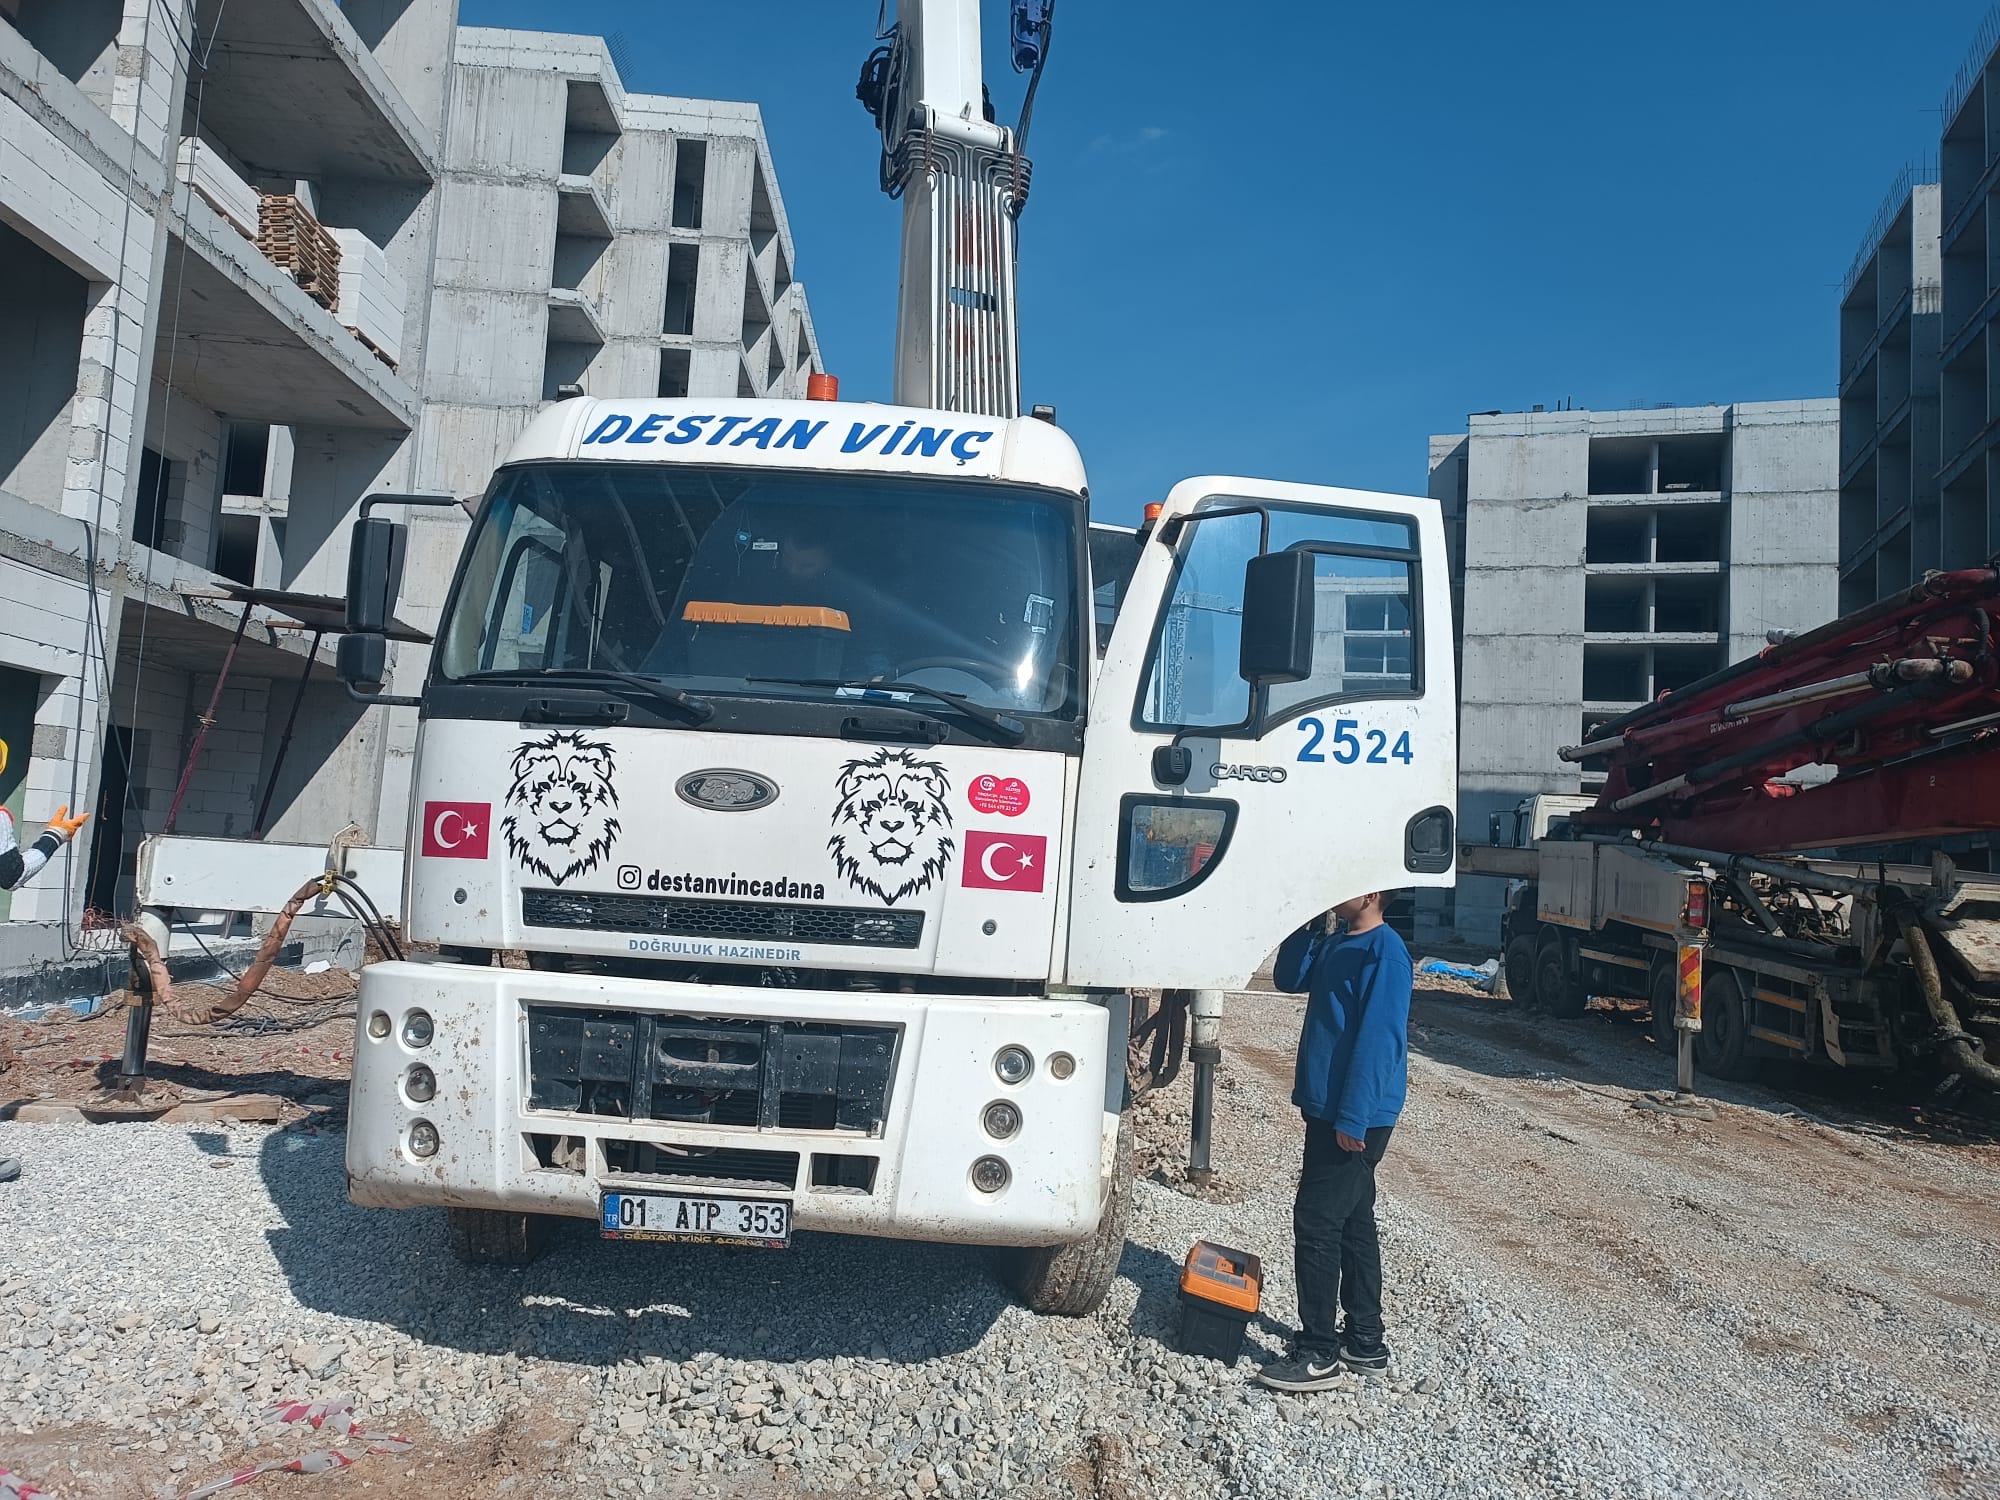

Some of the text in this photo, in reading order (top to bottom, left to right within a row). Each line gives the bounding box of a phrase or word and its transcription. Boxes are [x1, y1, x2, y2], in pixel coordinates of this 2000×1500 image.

[582, 414, 994, 466] DESTAN VİNÇ
[1209, 762, 1287, 784] CARGO
[647, 869, 825, 900] destanvincadana
[629, 938, 713, 956] DOĞRULUK
[606, 1213, 618, 1223] TR
[620, 1198, 785, 1235] 01 ATP 353
